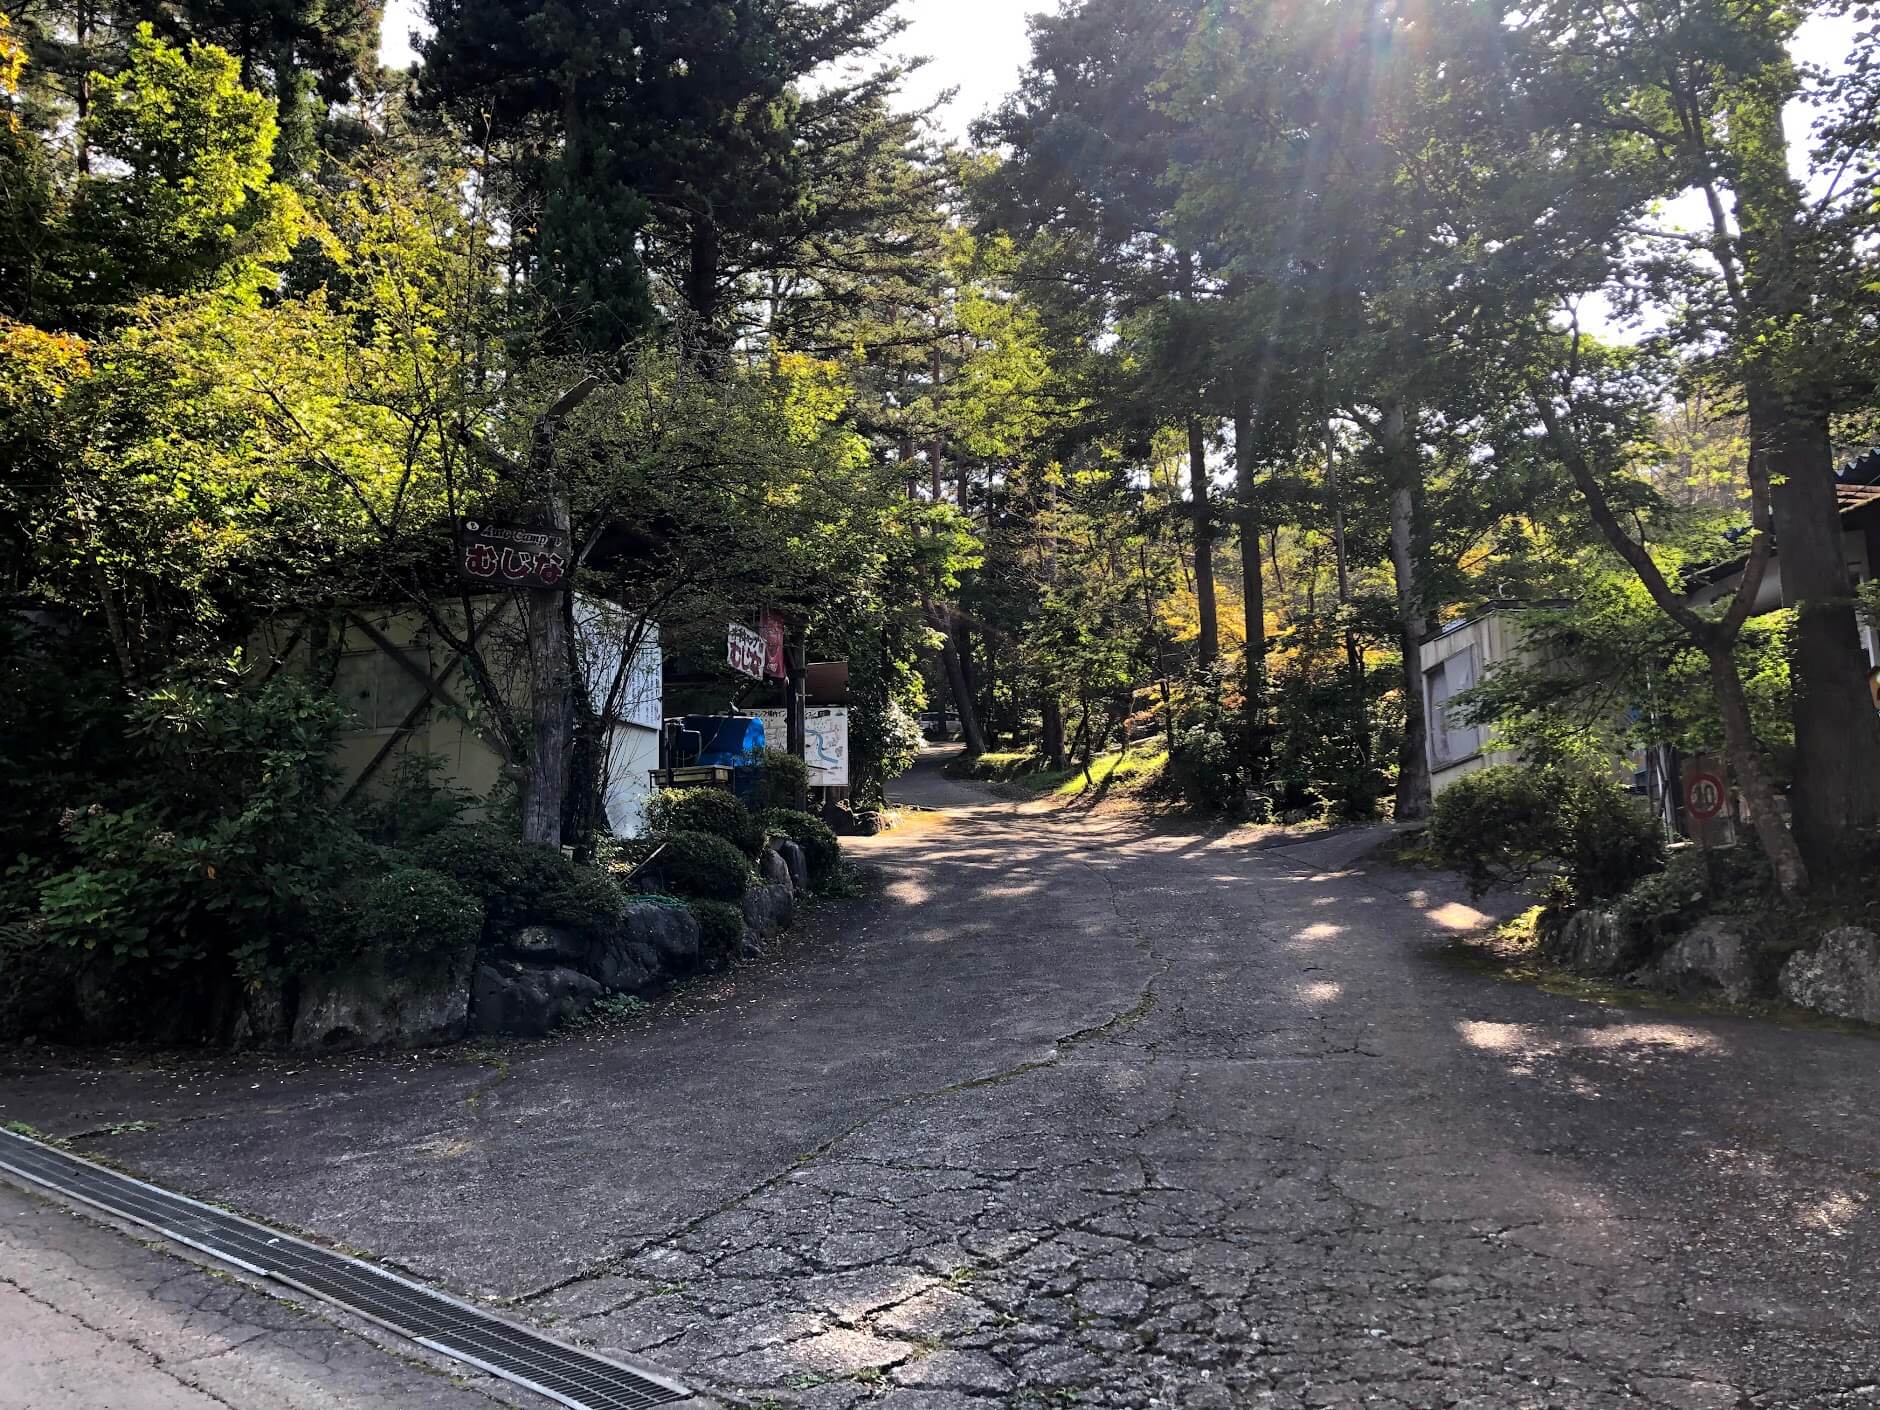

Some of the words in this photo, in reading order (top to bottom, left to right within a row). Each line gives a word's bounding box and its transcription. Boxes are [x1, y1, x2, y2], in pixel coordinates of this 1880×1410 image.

[465, 543, 565, 585] むじな
[730, 641, 762, 676] むじな
[1694, 783, 1715, 806] 10
